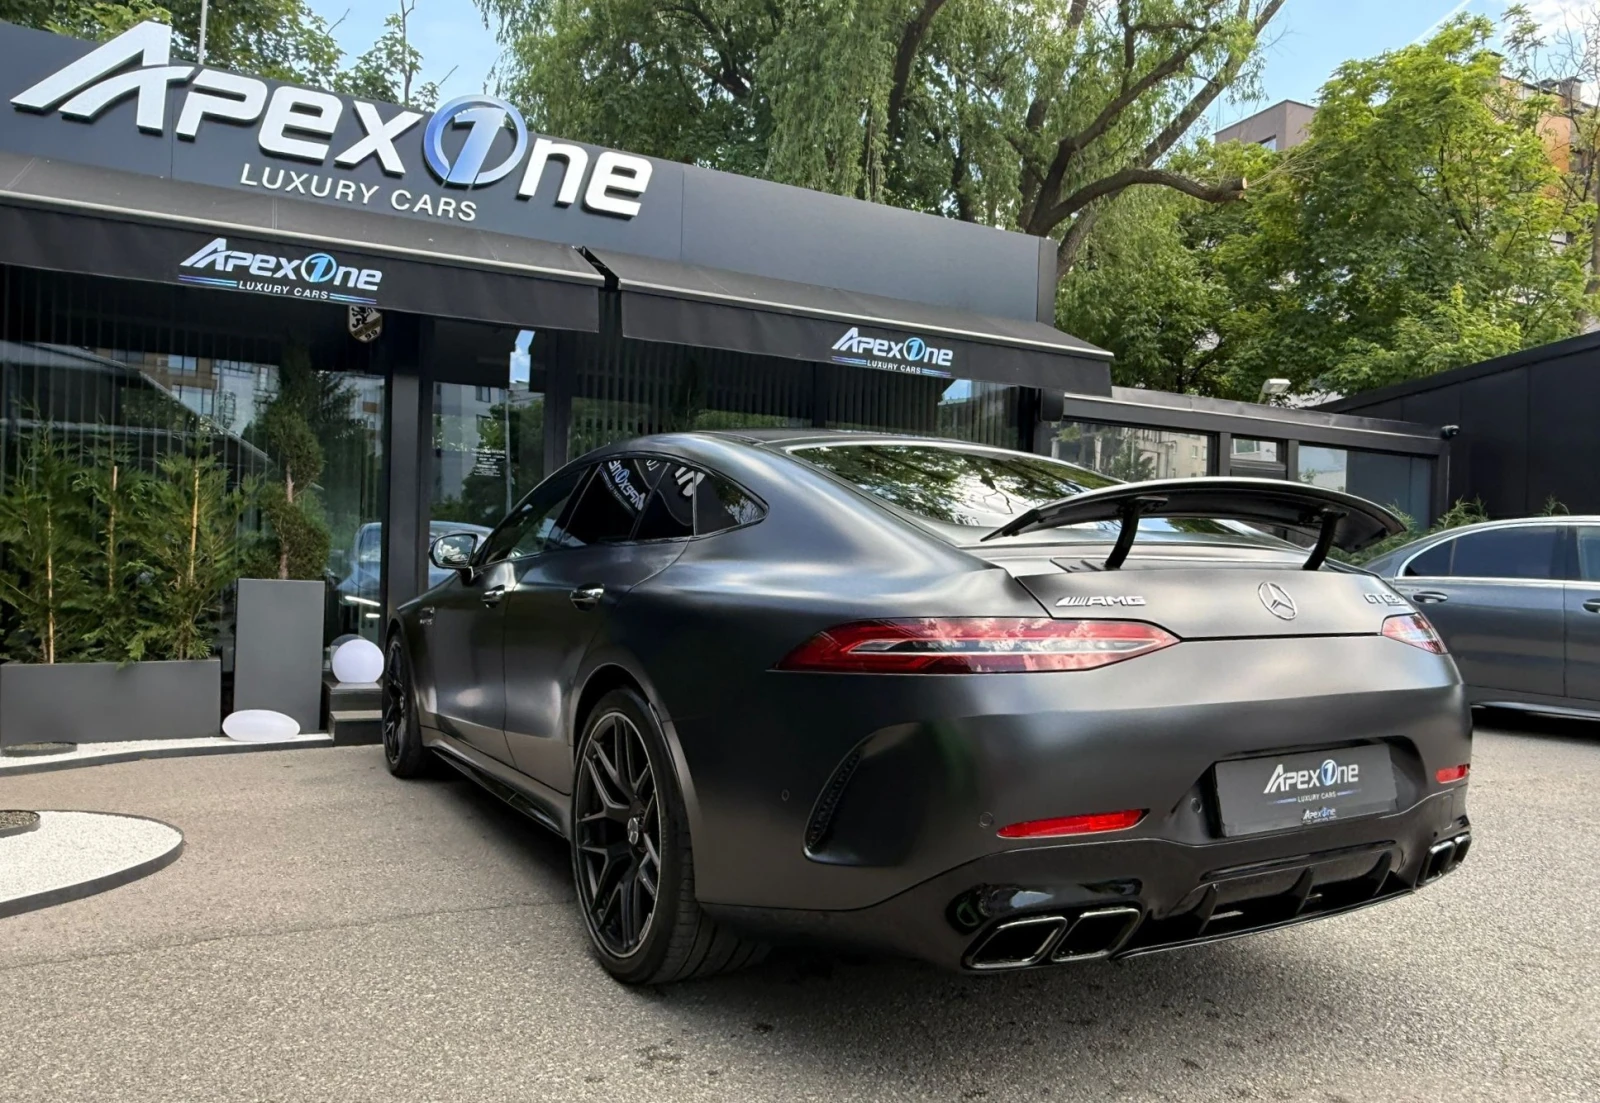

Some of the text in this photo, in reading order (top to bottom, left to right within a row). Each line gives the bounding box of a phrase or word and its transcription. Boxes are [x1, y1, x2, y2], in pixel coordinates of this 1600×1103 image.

[241, 163, 478, 222] LUXURY CARS
[238, 280, 328, 299] LUXURY CARS
[868, 360, 921, 374] LUXURY CARS
[1085, 595, 1147, 607] AMG
[1297, 790, 1337, 803] LUXURY CARS
